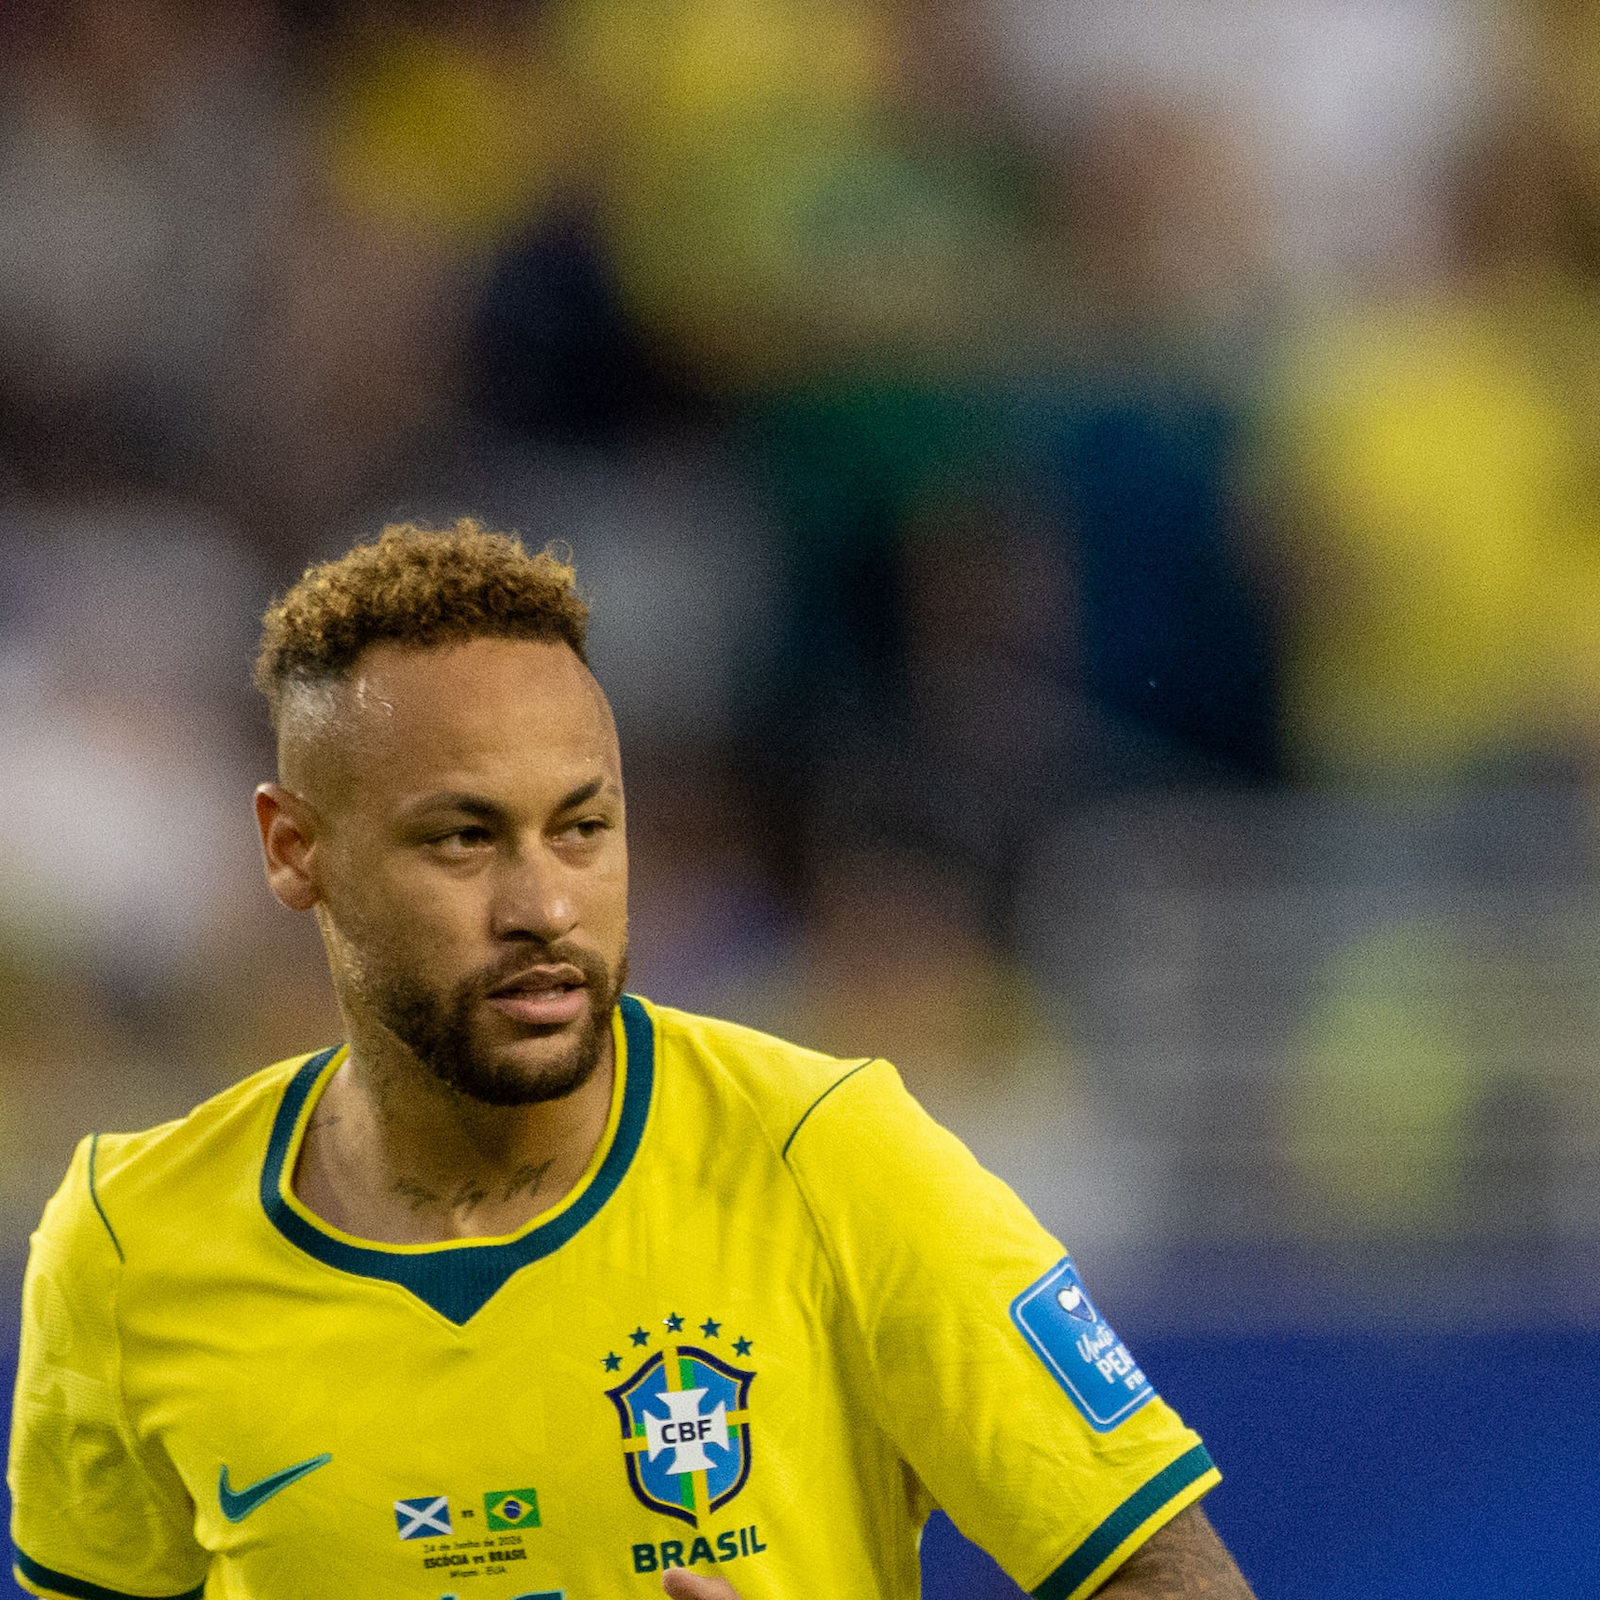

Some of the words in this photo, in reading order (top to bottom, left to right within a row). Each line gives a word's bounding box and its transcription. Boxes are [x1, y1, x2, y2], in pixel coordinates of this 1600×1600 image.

[1096, 1343, 1136, 1384] PEA
[661, 1418, 712, 1445] CBF
[488, 1549, 527, 1562] BRASIL
[632, 1524, 767, 1574] BRASIL
